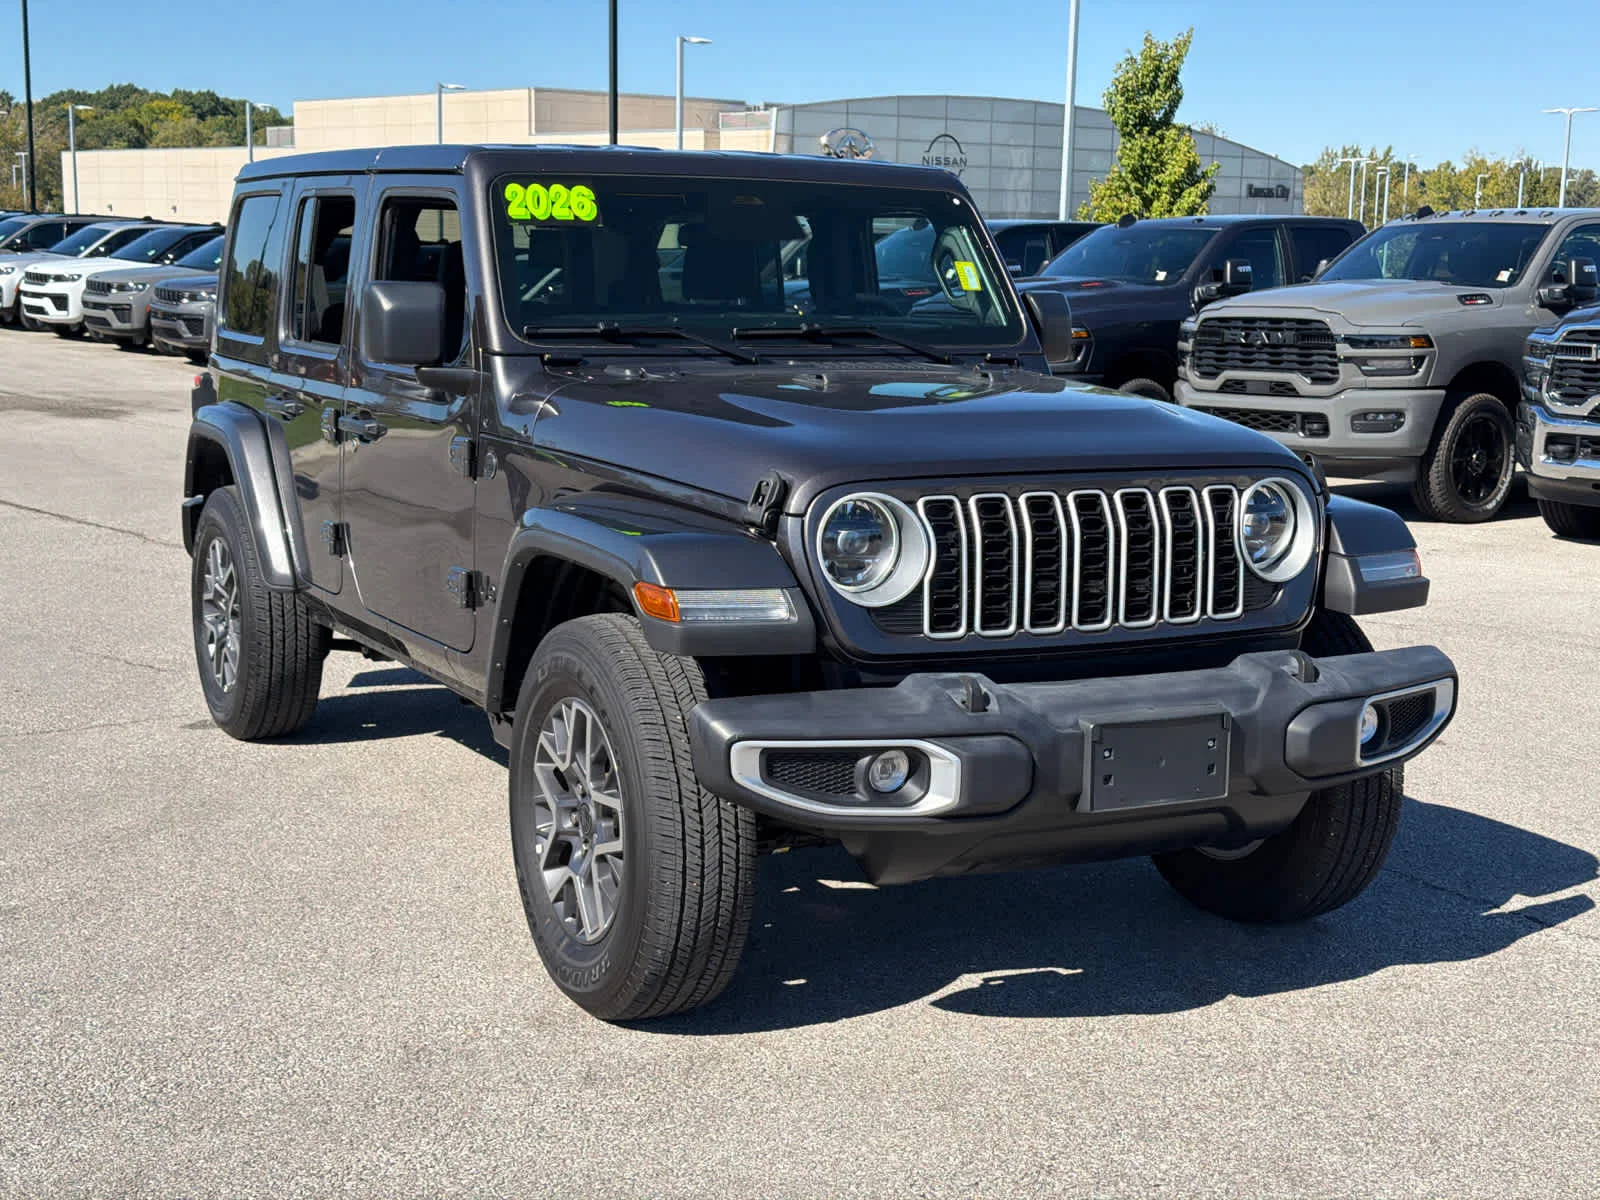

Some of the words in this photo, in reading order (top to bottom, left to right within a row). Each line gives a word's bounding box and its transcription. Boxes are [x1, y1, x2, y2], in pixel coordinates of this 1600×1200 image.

[922, 155, 967, 167] NISSAN
[504, 183, 597, 221] 2026
[1223, 328, 1294, 345] RAM
